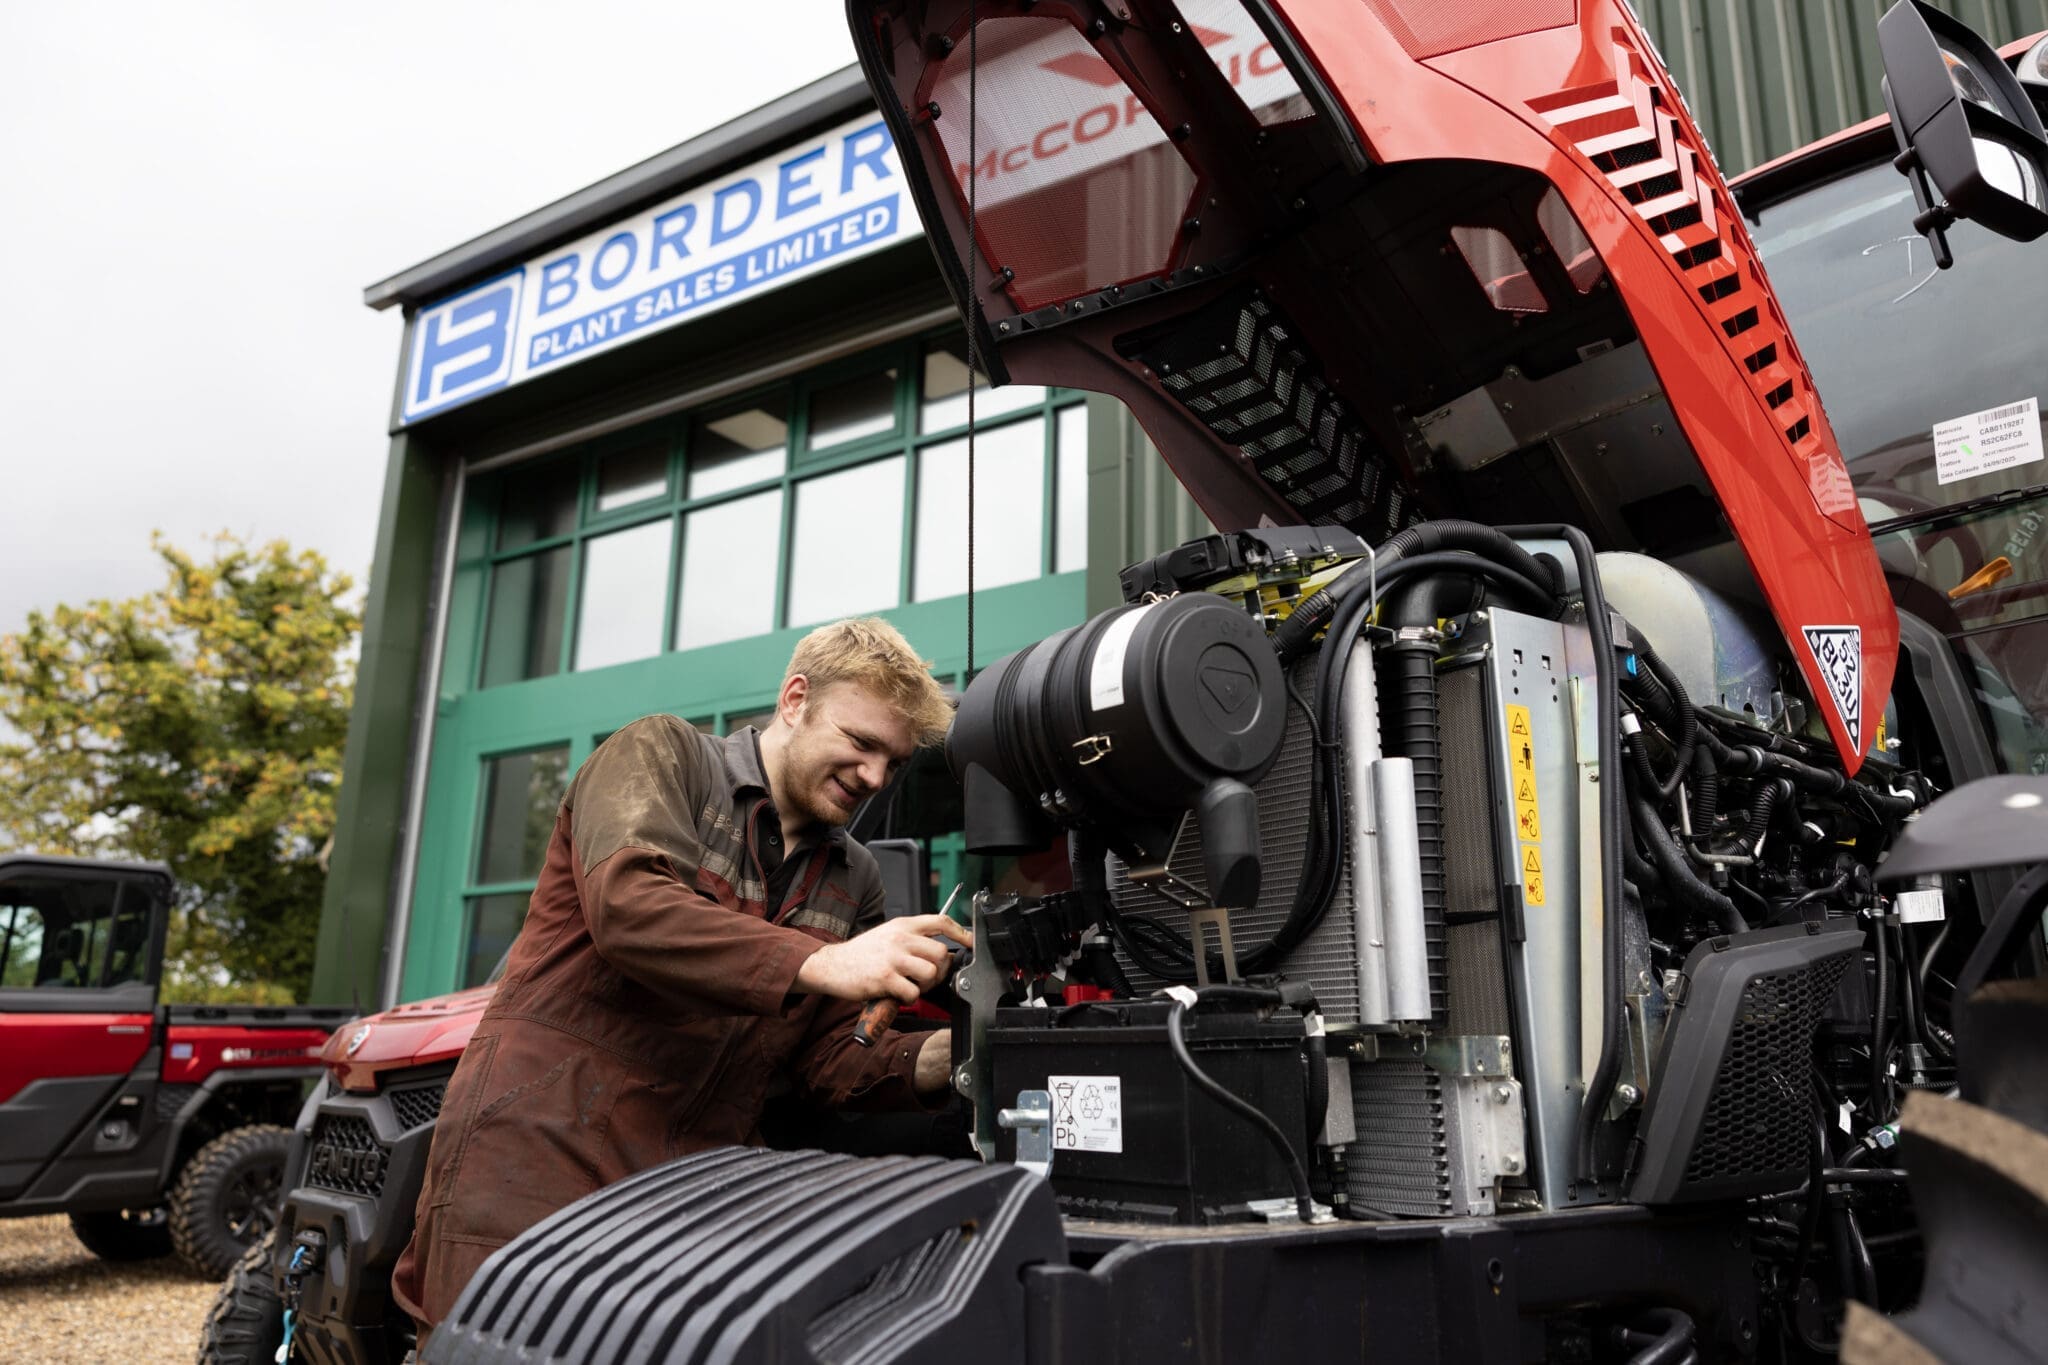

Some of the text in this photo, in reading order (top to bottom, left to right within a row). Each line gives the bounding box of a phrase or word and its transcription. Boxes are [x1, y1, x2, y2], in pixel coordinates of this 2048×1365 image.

[532, 205, 891, 363] PLANT SALES LIMITED
[538, 120, 894, 316] BORDER
[1056, 1127, 1077, 1147] Pb
